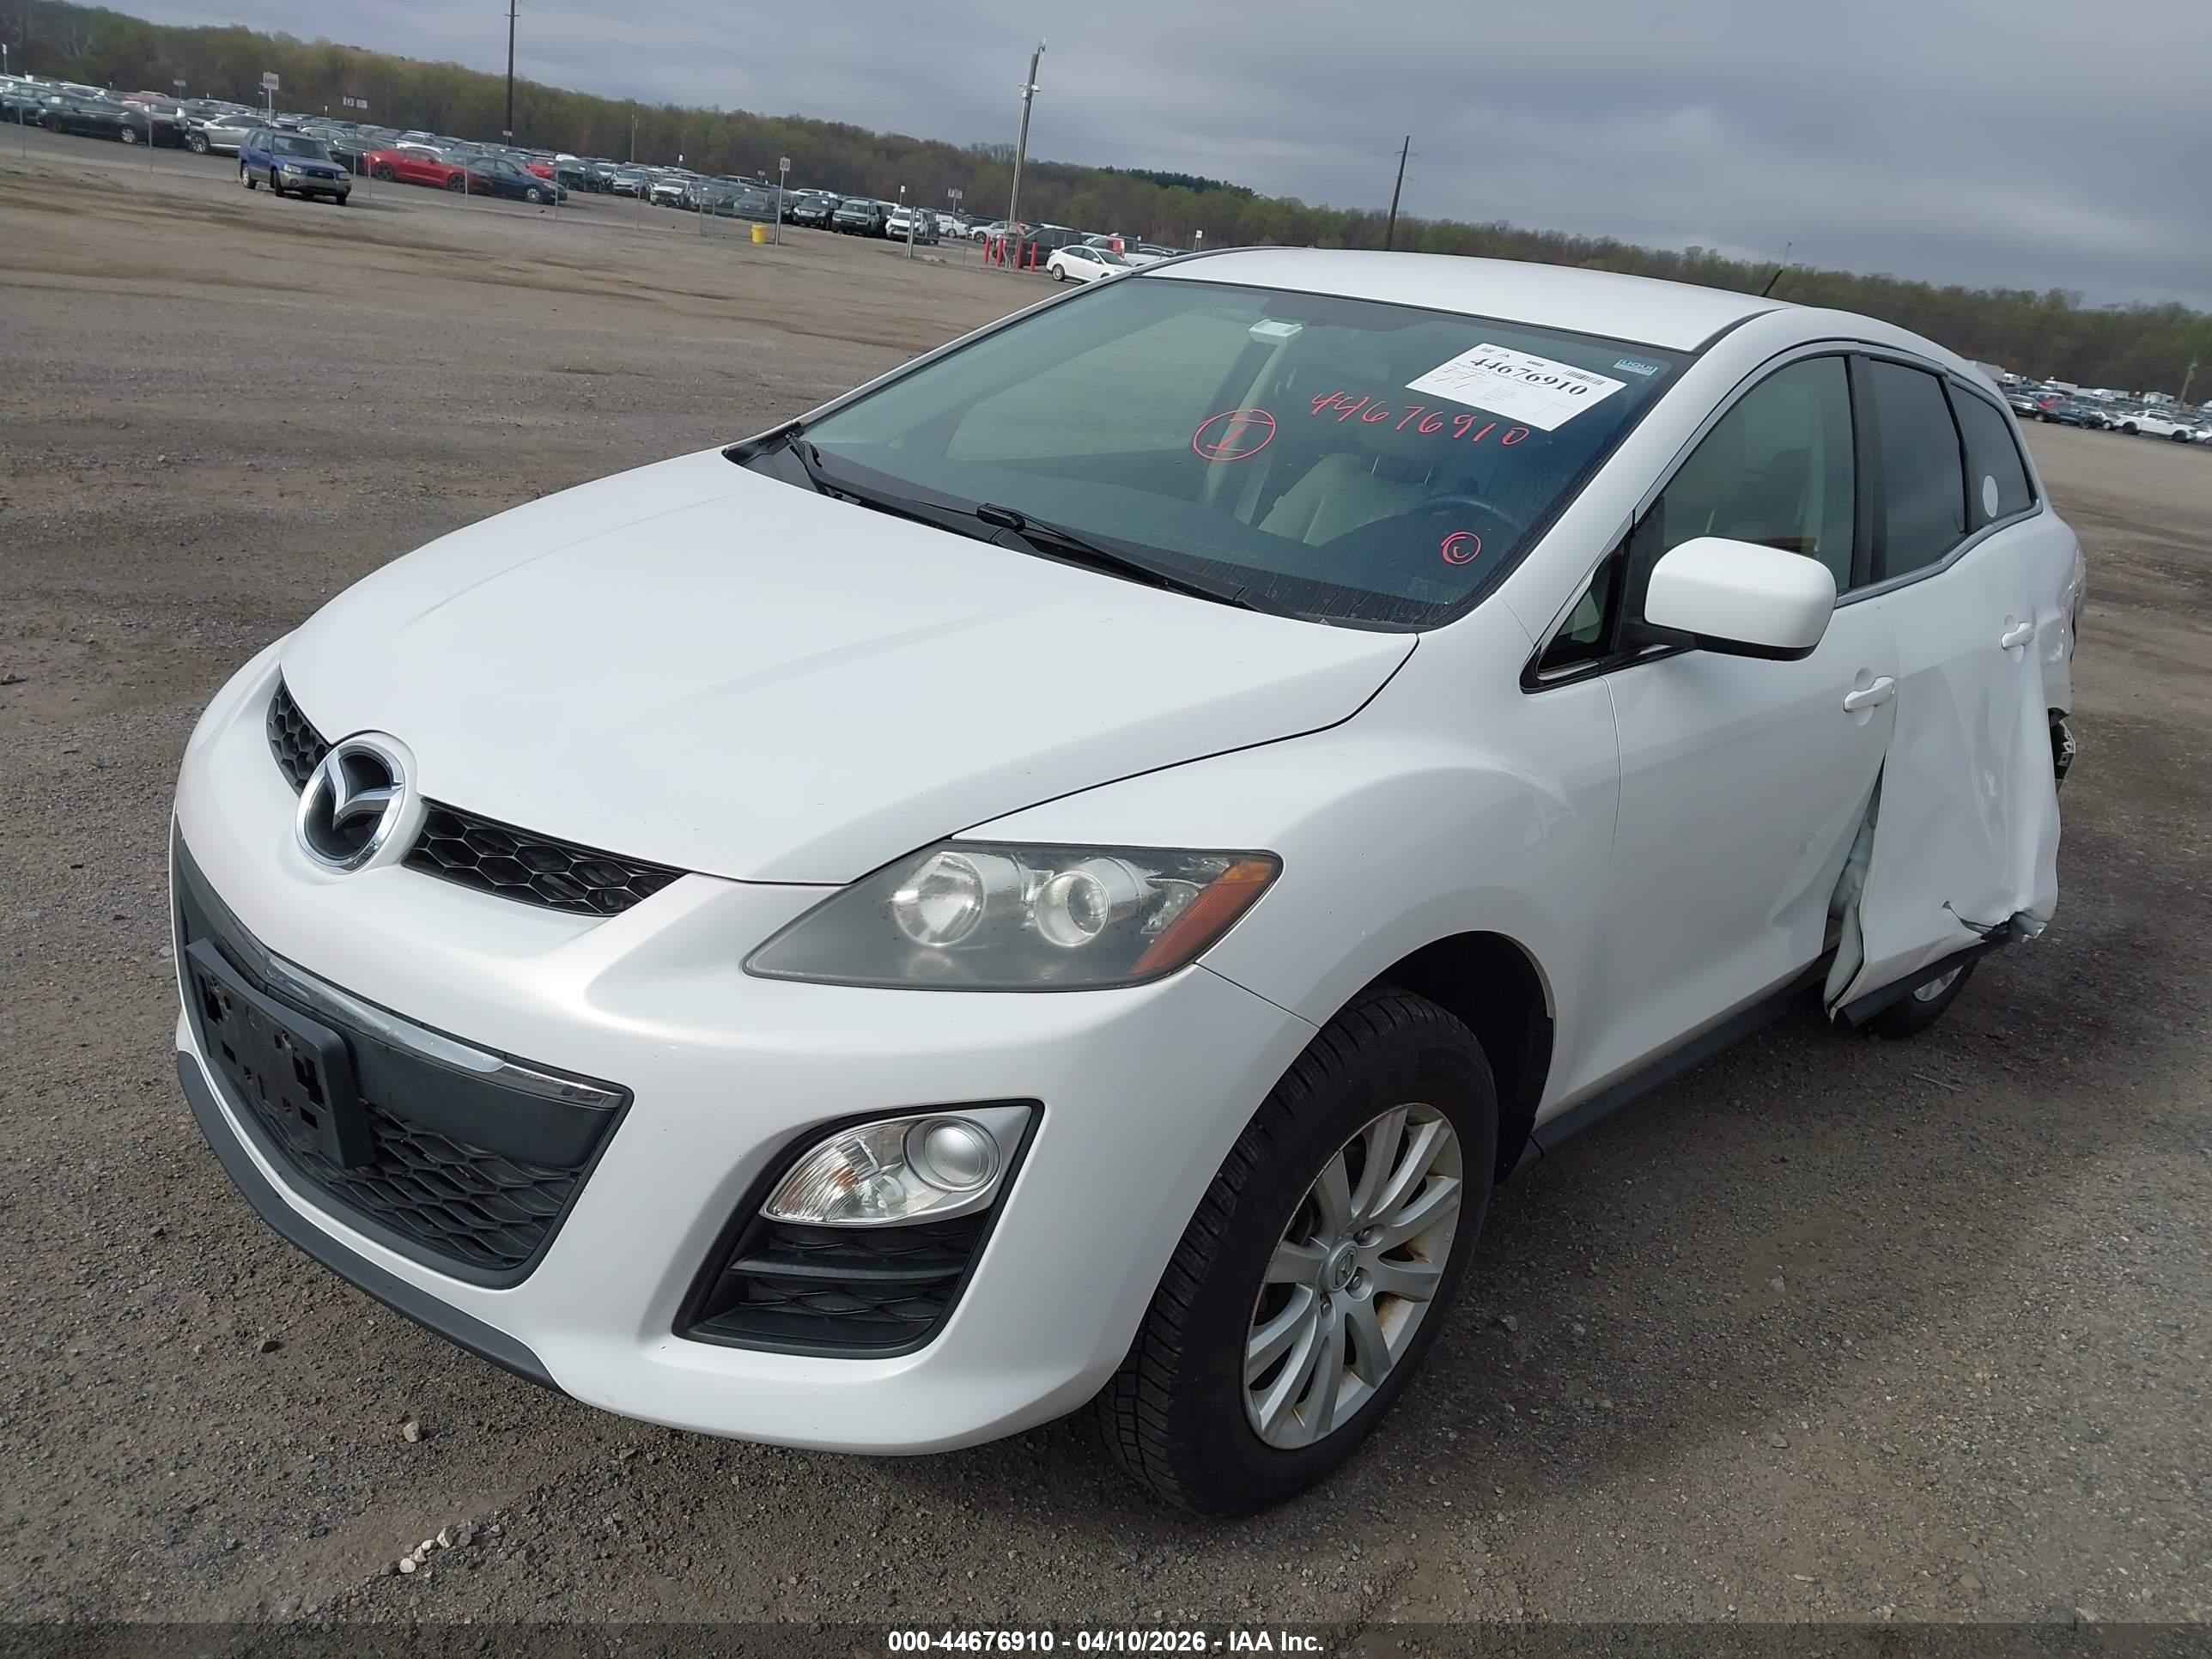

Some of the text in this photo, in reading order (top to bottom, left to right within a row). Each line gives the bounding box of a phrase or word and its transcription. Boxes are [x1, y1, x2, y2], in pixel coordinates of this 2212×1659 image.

[781, 160, 790, 170] 20
[1469, 356, 1589, 397] 44676910
[1311, 391, 1529, 446] 44676910
